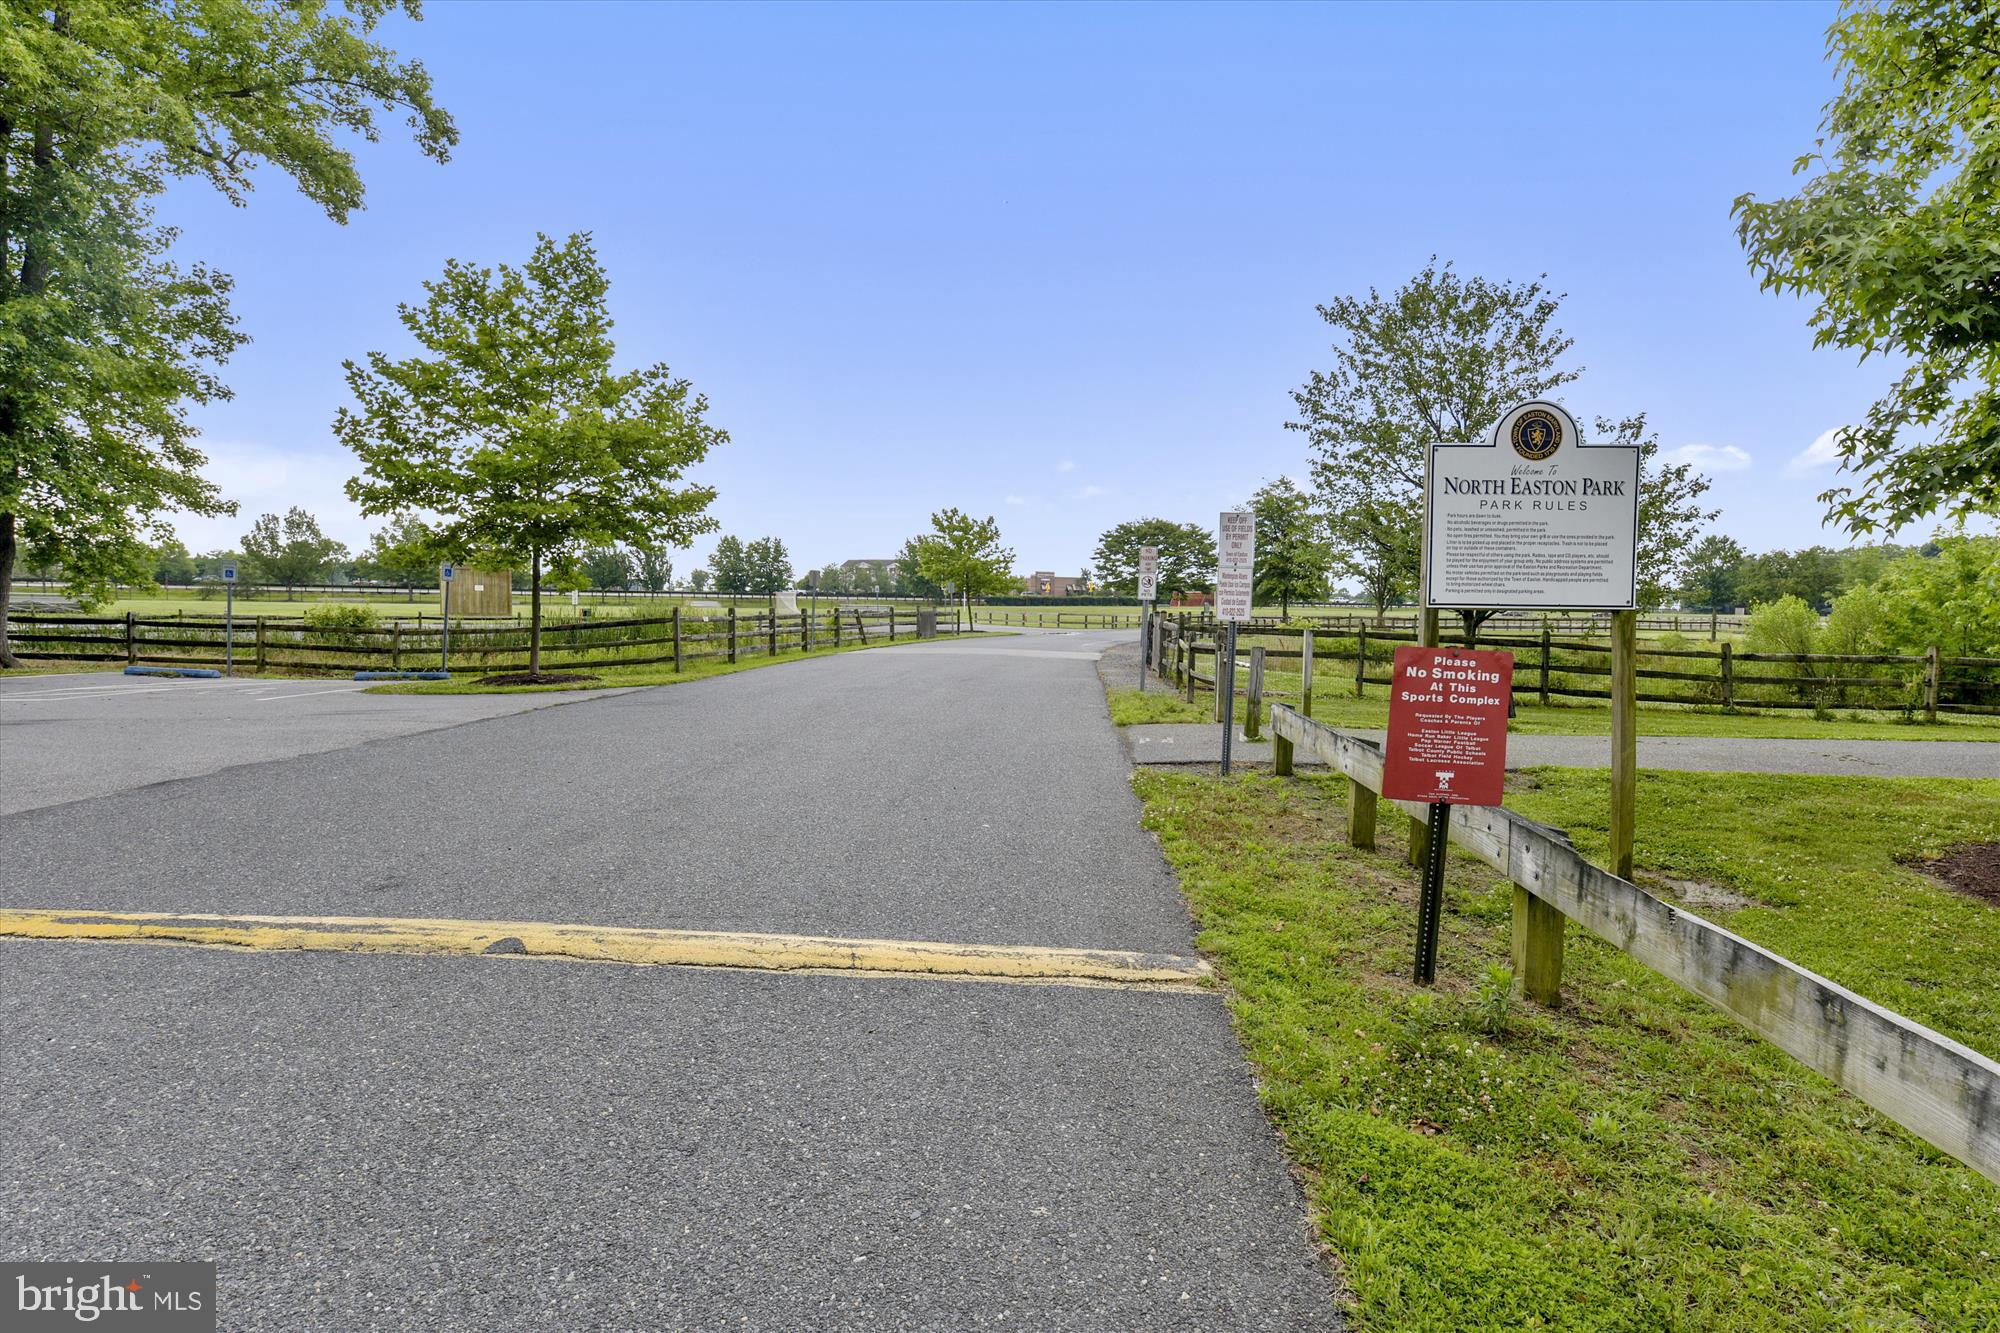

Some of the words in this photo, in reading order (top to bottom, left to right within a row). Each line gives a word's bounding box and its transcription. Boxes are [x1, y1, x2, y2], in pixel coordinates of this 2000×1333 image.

[1523, 412, 1547, 420] EASTON
[1546, 414, 1560, 443] MARYLAND
[1516, 446, 1543, 459] FOUNDED
[1510, 465, 1543, 476] Welcome
[1548, 465, 1559, 476] To
[1444, 477, 1505, 495] NORTH
[1510, 478, 1577, 496] EASTON
[1582, 478, 1625, 496] PARK
[1480, 500, 1522, 510] PARK
[1533, 501, 1588, 511] RULES
[1434, 656, 1476, 667] Please
[1406, 667, 1427, 677] No
[1432, 668, 1499, 683] Smoking
[1430, 682, 1443, 691] At
[1449, 683, 1476, 692] This
[1401, 692, 1443, 702] Sports
[1449, 694, 1500, 706] Complex
